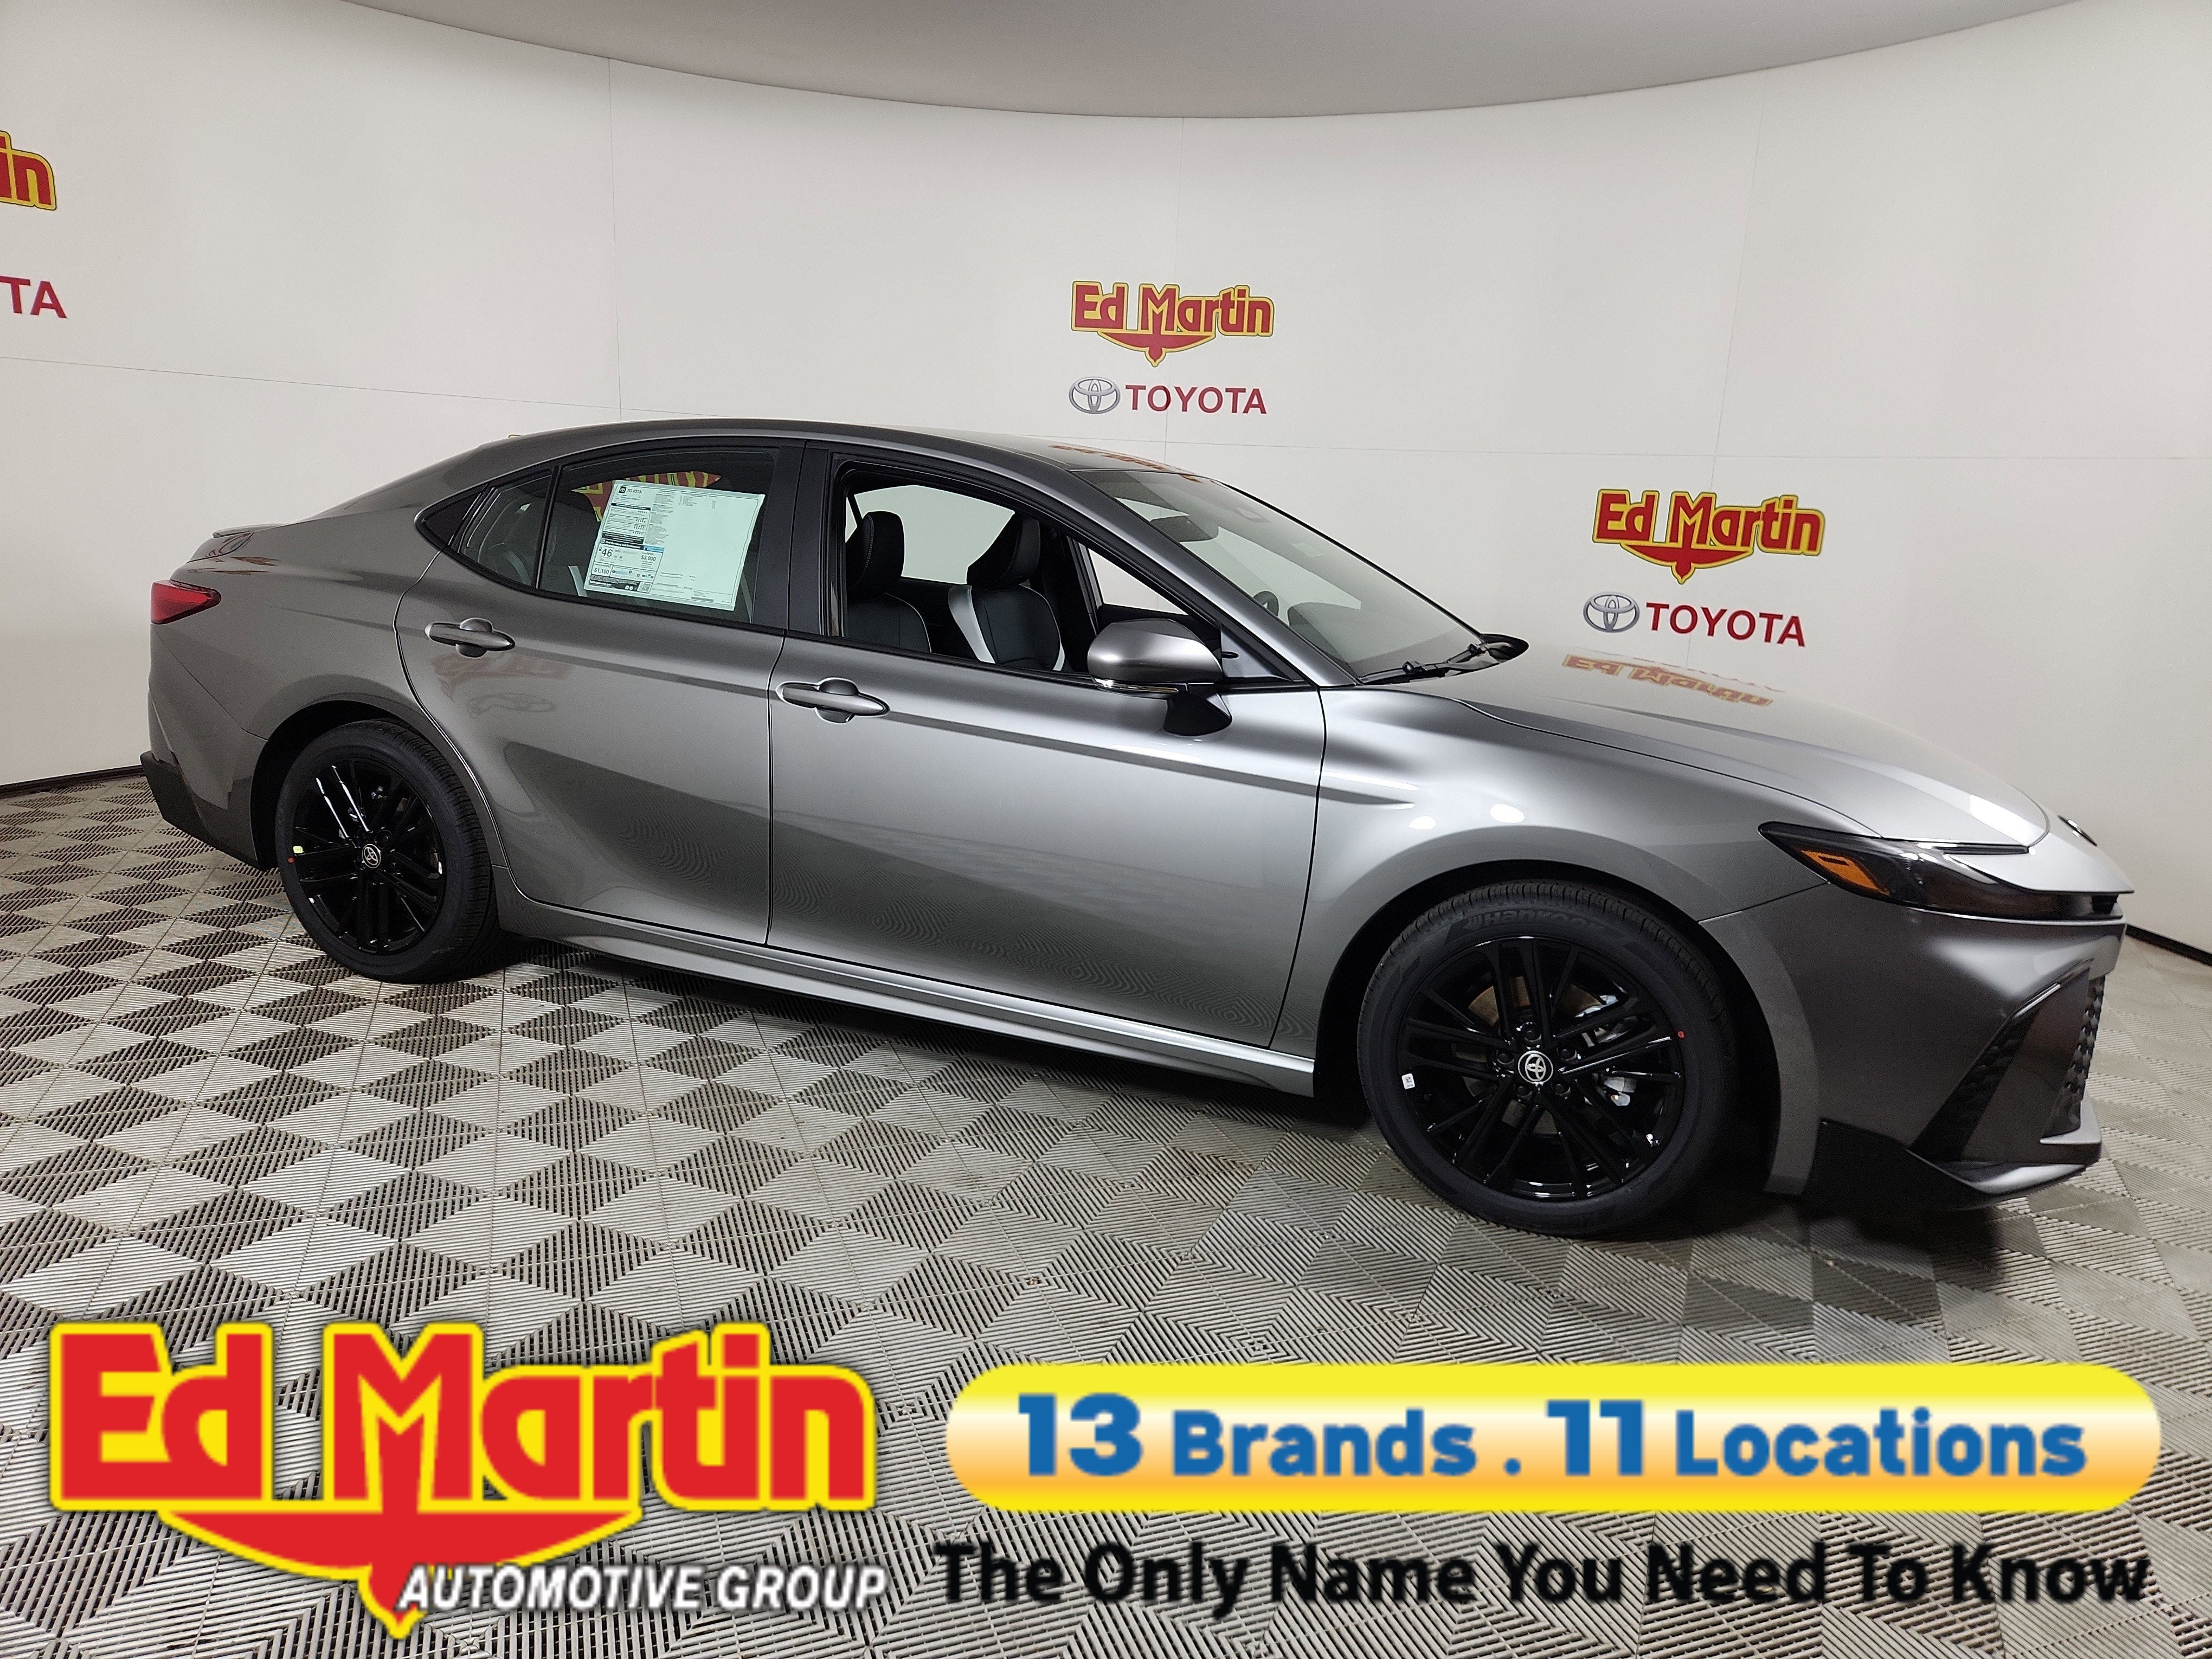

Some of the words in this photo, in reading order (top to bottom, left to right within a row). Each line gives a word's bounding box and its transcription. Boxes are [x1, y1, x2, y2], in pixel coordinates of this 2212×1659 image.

[1073, 283, 1126, 330] Ed
[1139, 285, 1272, 334] Martin
[1126, 384, 1267, 414] TOYOTA
[1594, 491, 1657, 542] Ed
[1669, 492, 1822, 553] Martin
[601, 548, 613, 557] 46
[1646, 602, 1805, 647] TOYOTA
